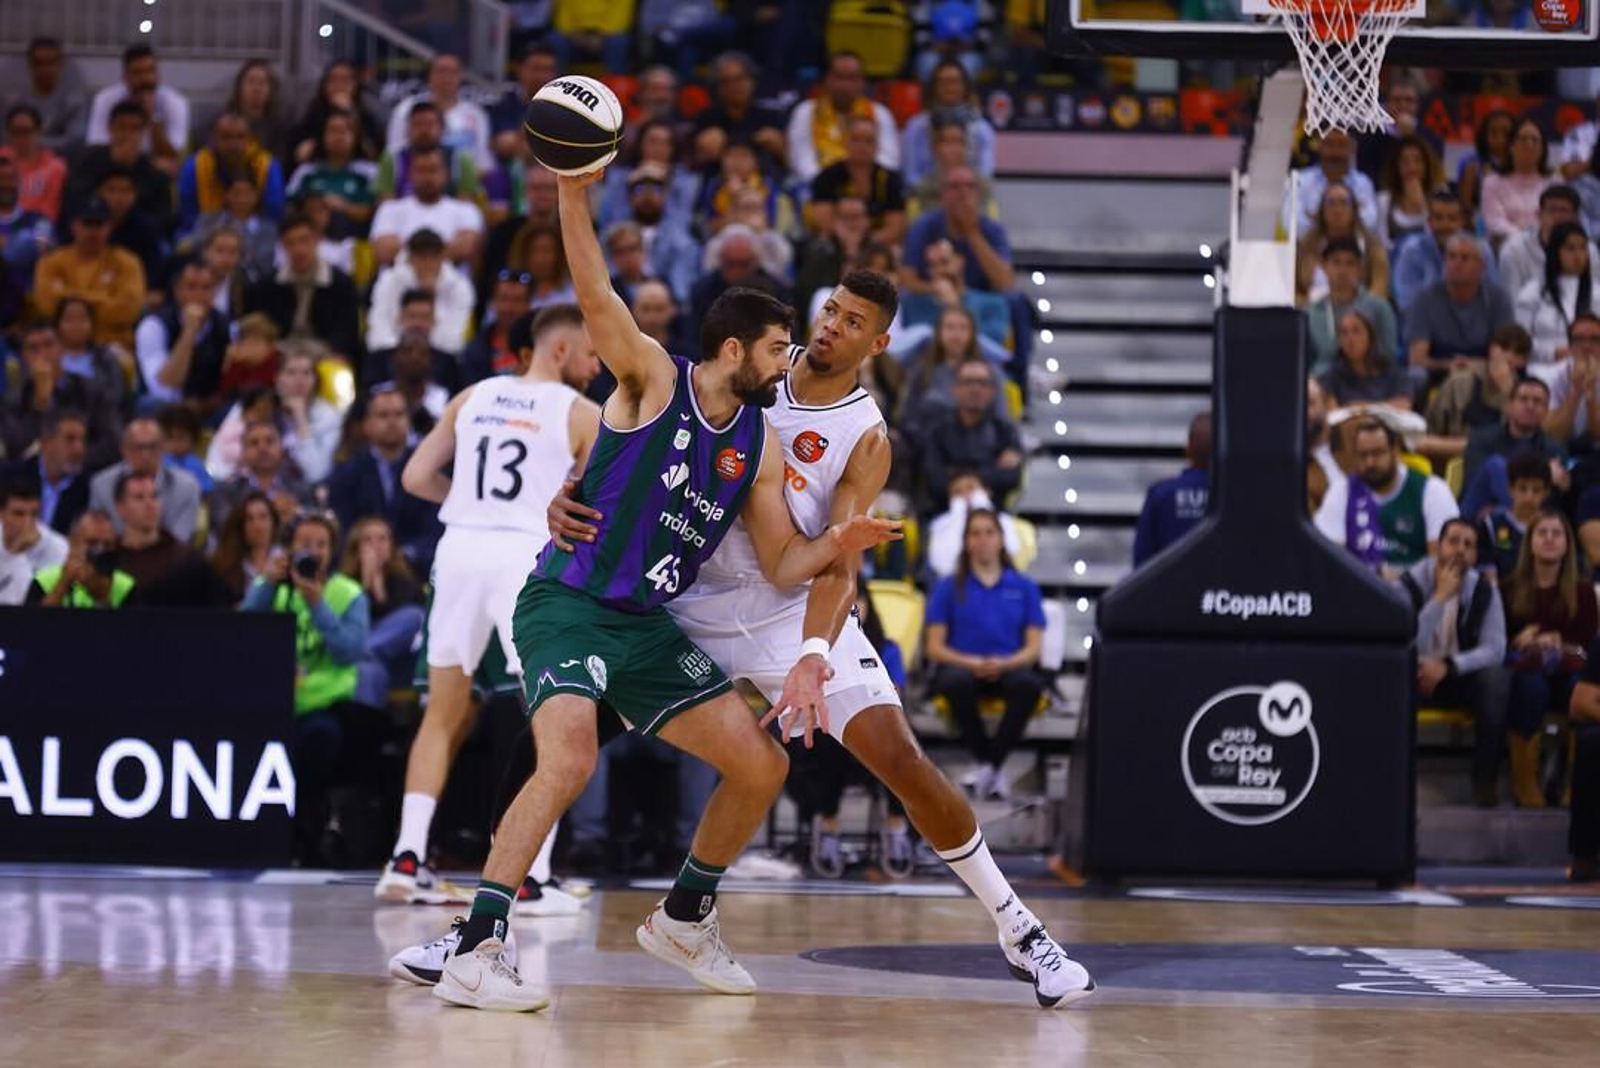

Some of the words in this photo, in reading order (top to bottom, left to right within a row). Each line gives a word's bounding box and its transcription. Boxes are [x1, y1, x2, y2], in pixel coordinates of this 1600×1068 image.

[475, 436, 528, 502] 13
[1202, 590, 1312, 619] #CopaACB
[1207, 740, 1273, 766] Copa
[0, 735, 296, 821] ALONA
[1238, 765, 1281, 790] Rey
